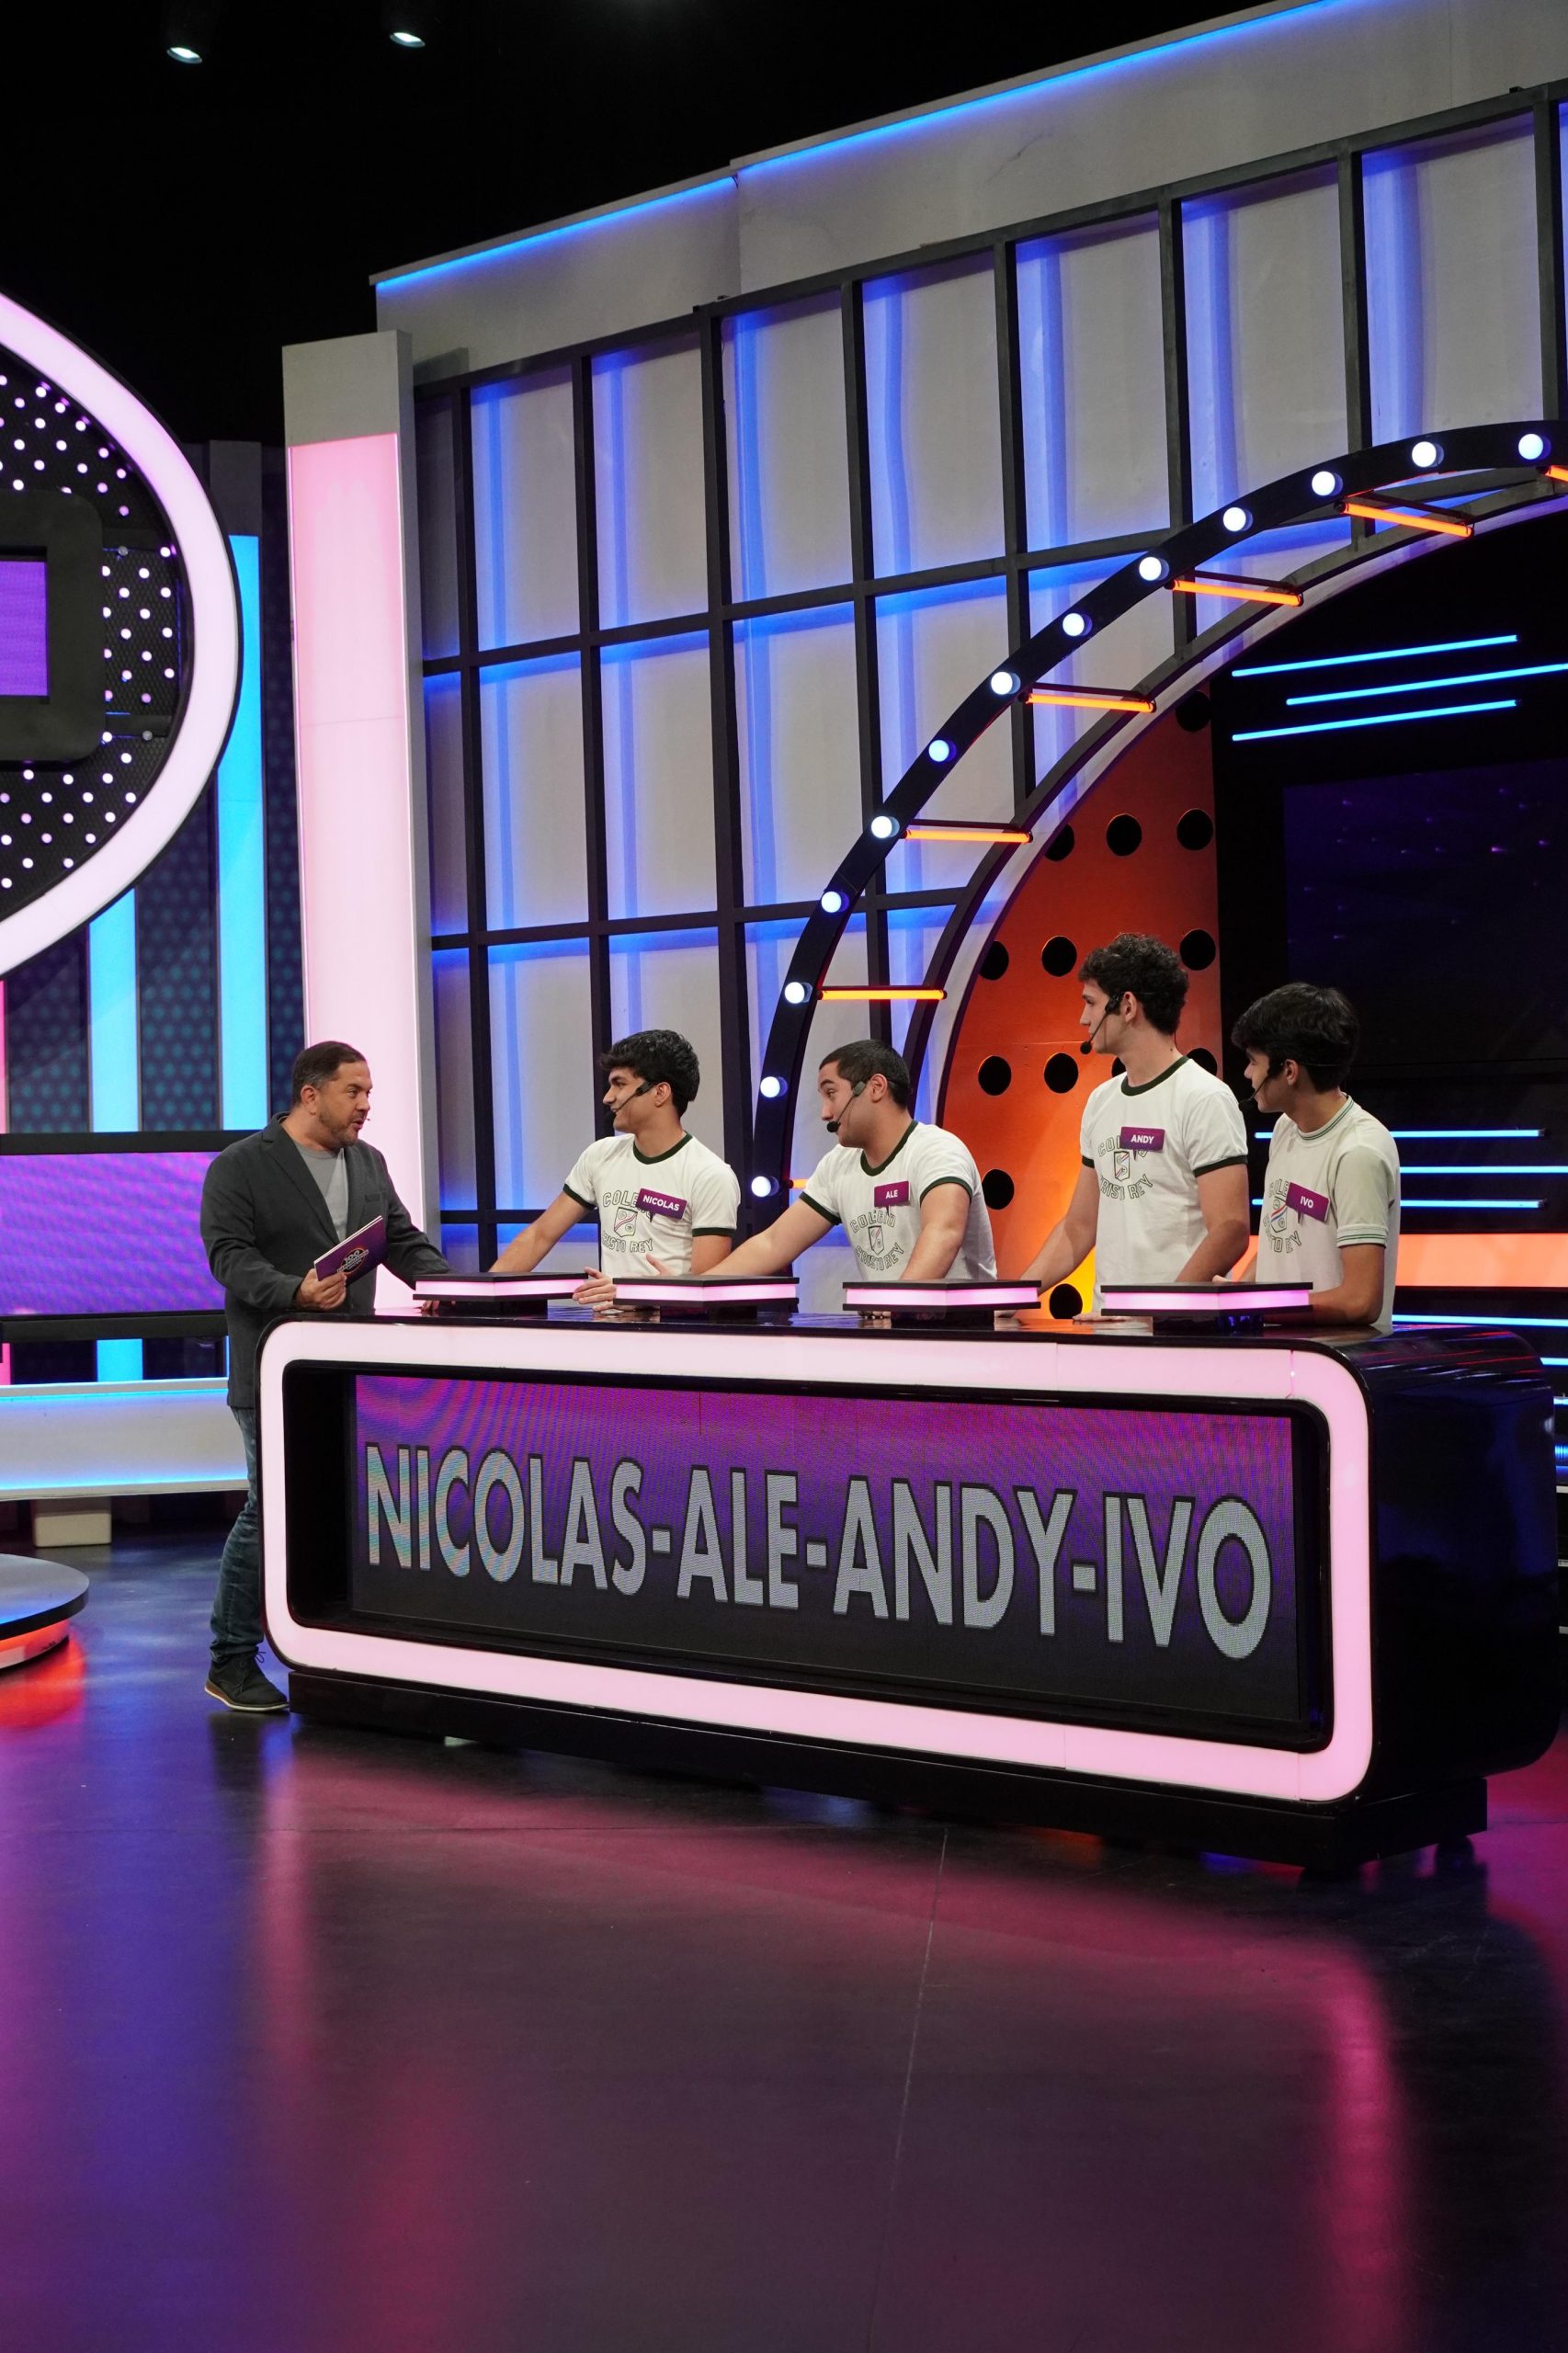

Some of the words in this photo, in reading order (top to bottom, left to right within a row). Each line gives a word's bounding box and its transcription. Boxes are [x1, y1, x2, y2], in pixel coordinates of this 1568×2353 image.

[1131, 1134, 1154, 1144] ANDY
[885, 1189, 899, 1199] ALE
[1127, 1174, 1153, 1199] REY
[642, 1195, 680, 1211] NICOLAS
[1300, 1196, 1314, 1209] IVO
[630, 1237, 653, 1254] REY
[883, 1242, 904, 1269] REY
[366, 1444, 1273, 1660] NICOLAS-ALE-ANDY-IVO
